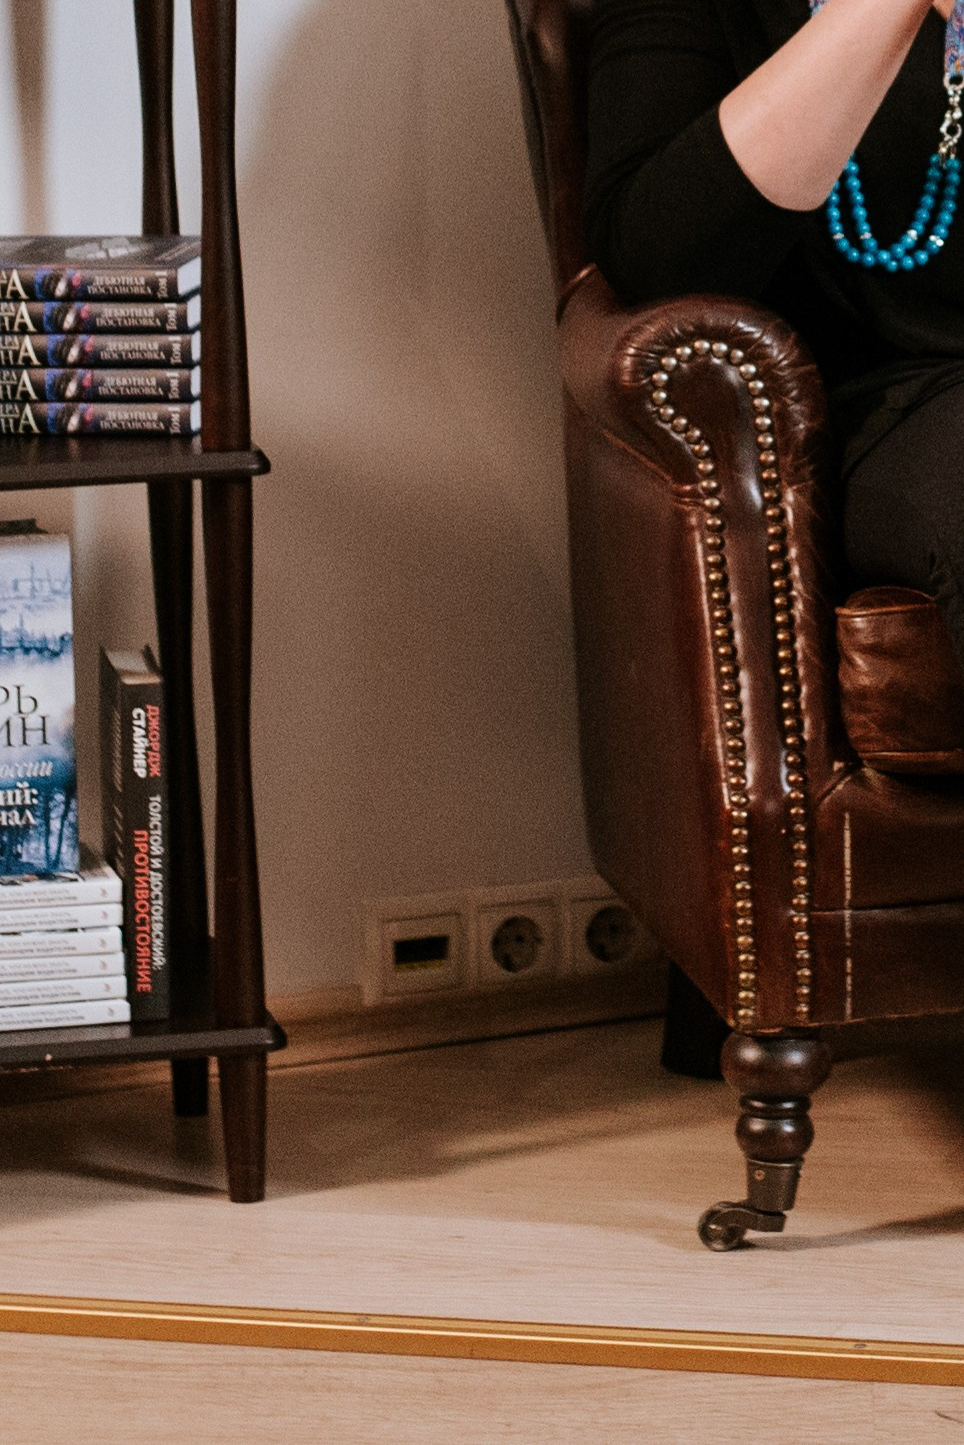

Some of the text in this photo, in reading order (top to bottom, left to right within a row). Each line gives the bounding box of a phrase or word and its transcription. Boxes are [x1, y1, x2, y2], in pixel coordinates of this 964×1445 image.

[132, 707, 148, 779] СТАЙНЕР
[147, 704, 161, 777] ДЖОРДЖ
[133, 829, 152, 993] ПРОТИВОСТОЯНИЕ
[150, 794, 166, 971] ТОЛСТОЙ И ДОСТОЕВСКИЙ:
